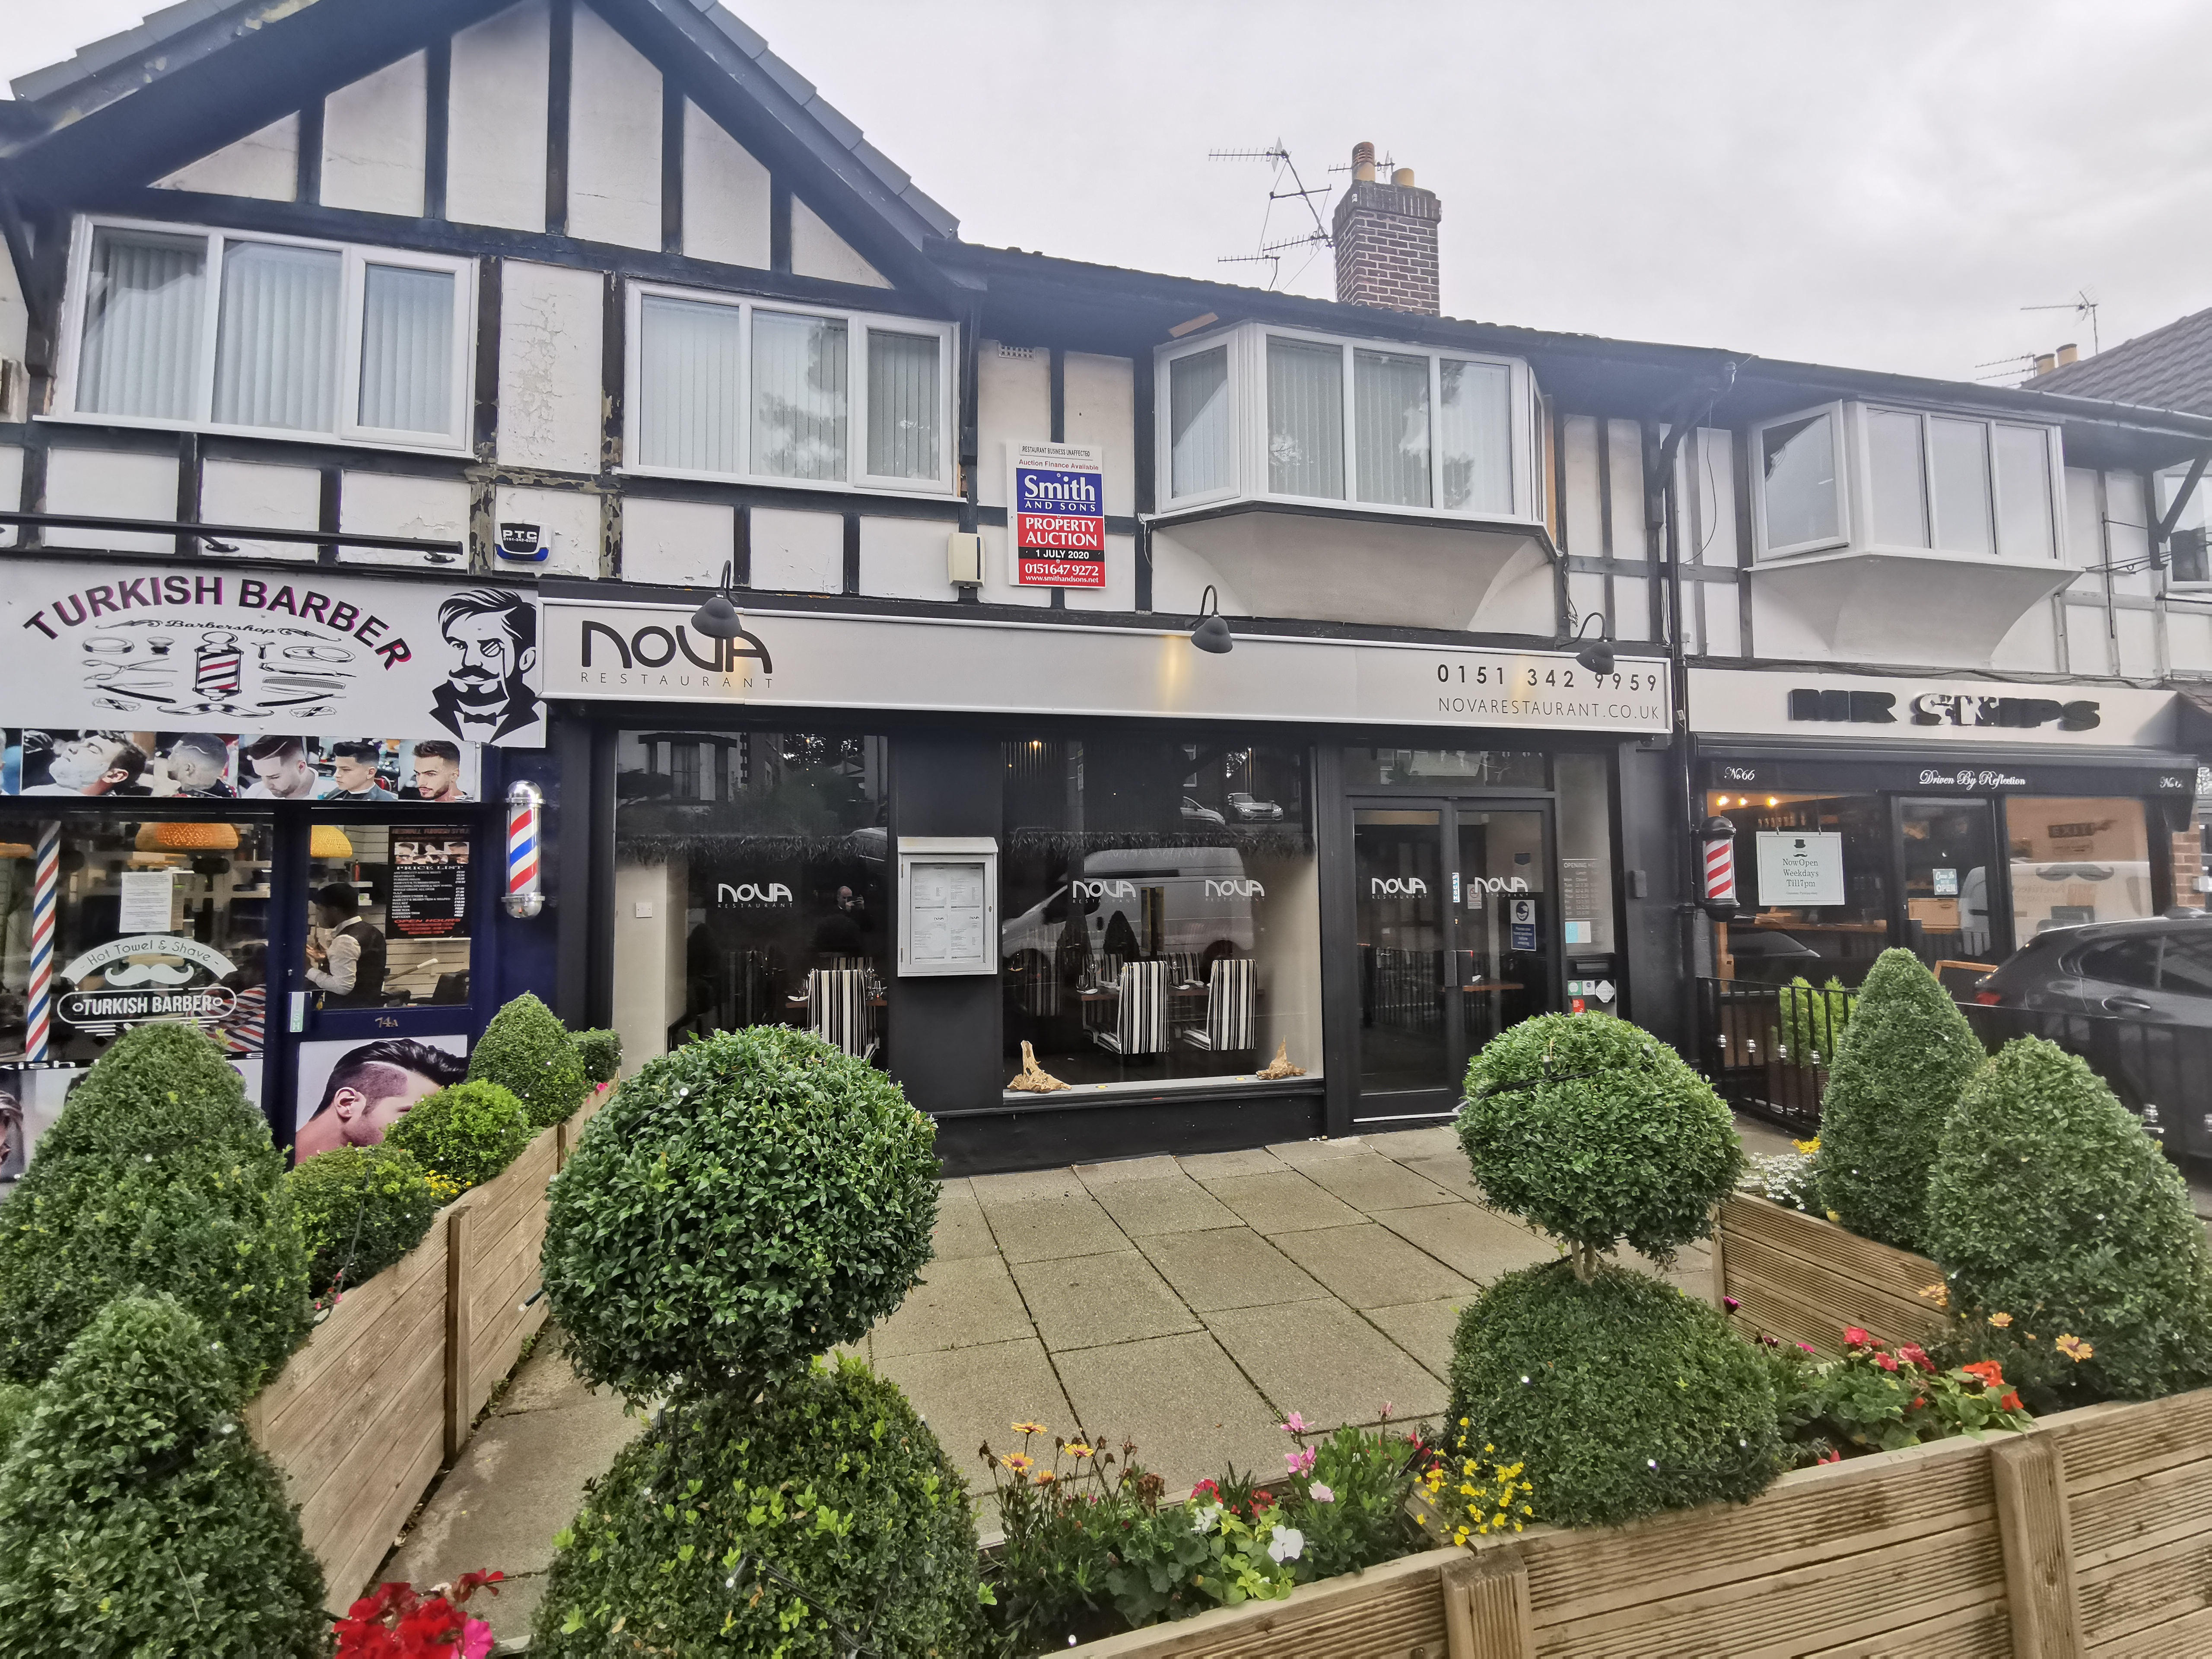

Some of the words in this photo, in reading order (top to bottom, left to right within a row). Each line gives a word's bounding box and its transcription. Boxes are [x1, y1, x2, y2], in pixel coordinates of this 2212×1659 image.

[1024, 475, 1095, 501] Smith
[1025, 501, 1052, 509] AND
[1060, 503, 1096, 512] SONS
[1026, 517, 1096, 532] PROPERTY
[502, 530, 537, 539] PTC
[1026, 532, 1097, 547] AUCTION
[1036, 549, 1040, 557] 1
[1043, 550, 1066, 558] JULY
[1068, 551, 1089, 559] 2020
[1025, 563, 1049, 574] 0151
[1050, 564, 1071, 575] 647
[1072, 565, 1099, 576] 9272
[1026, 575, 1099, 583] www.smithandsons.net
[22, 575, 223, 641] TURKISH
[238, 578, 413, 672] BARBER
[165, 620, 276, 634] Barbershop
[582, 620, 772, 674] NOVA
[581, 672, 772, 689] RESTAURANT
[1437, 664, 1503, 685] 0151
[1527, 668, 1574, 687] 342
[1595, 673, 1656, 691] 9959
[1439, 697, 1659, 720] NOVARESTAURANT.CO.UK
[1919, 769, 1955, 784] Driven
[1957, 770, 1977, 790] By
[1979, 771, 2026, 789] Reflection
[1783, 869, 1819, 878] Weekdays
[718, 883, 793, 902] NOVA
[1073, 880, 1136, 898] NOVA
[1205, 880, 1265, 896] NOVA
[1372, 877, 1427, 894] NOVA
[1475, 877, 1528, 893] NOVA
[86, 949, 111, 966] Hot
[114, 940, 153, 955] Towel
[158, 940, 167, 950] &
[172, 941, 211, 962] Shave
[83, 997, 148, 1016] TURKISH
[153, 995, 212, 1012] BARBER
